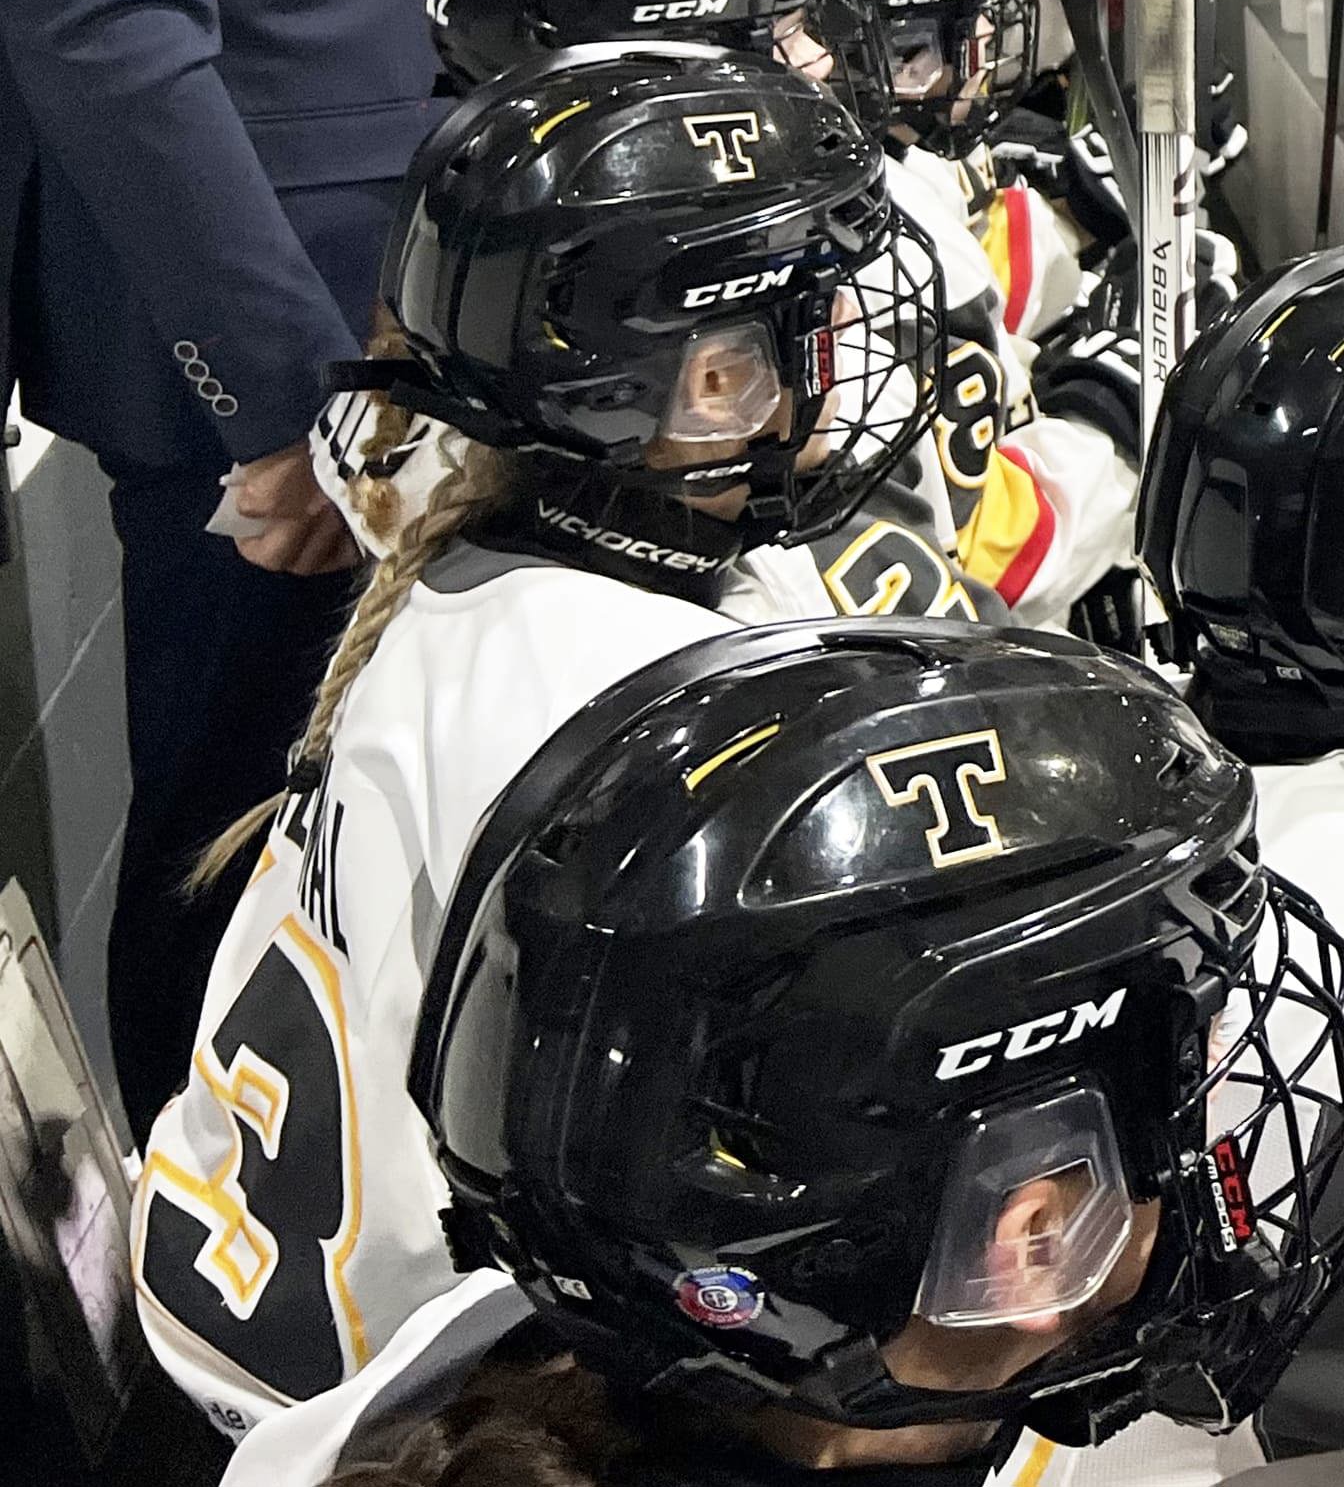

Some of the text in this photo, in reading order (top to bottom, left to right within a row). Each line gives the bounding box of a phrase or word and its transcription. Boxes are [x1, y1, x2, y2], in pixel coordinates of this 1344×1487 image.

[683, 112, 760, 183] T
[683, 265, 793, 308] CCM
[866, 729, 1007, 868] T
[935, 988, 1128, 1080] CCM
